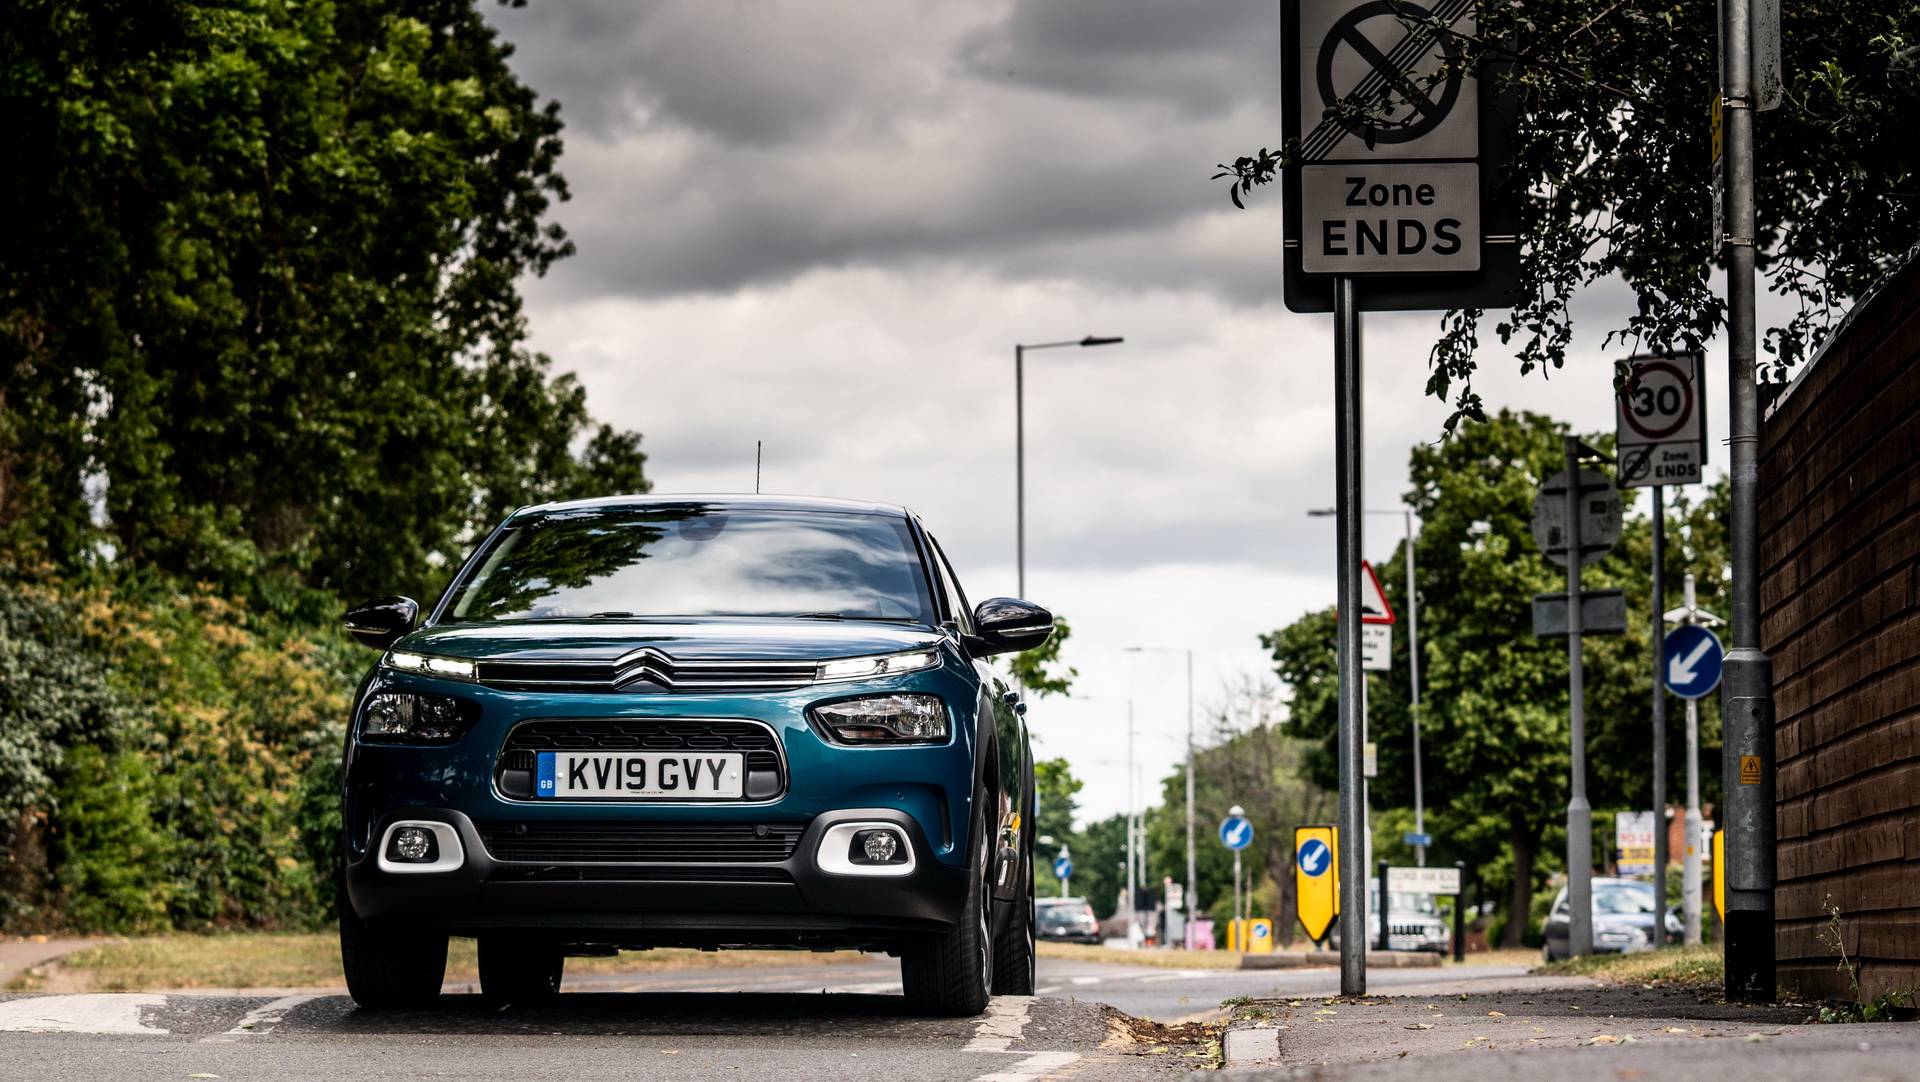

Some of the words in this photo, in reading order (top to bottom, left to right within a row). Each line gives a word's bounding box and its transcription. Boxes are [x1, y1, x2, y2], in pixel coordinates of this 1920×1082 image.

[1345, 177, 1435, 206] Zone
[1322, 218, 1462, 255] ENDS
[1634, 385, 1681, 417] 30
[1655, 463, 1697, 478] ENDS
[1662, 451, 1689, 461] Zone
[540, 780, 553, 789] GB
[568, 757, 646, 790] KV19
[658, 758, 727, 791] GVY
